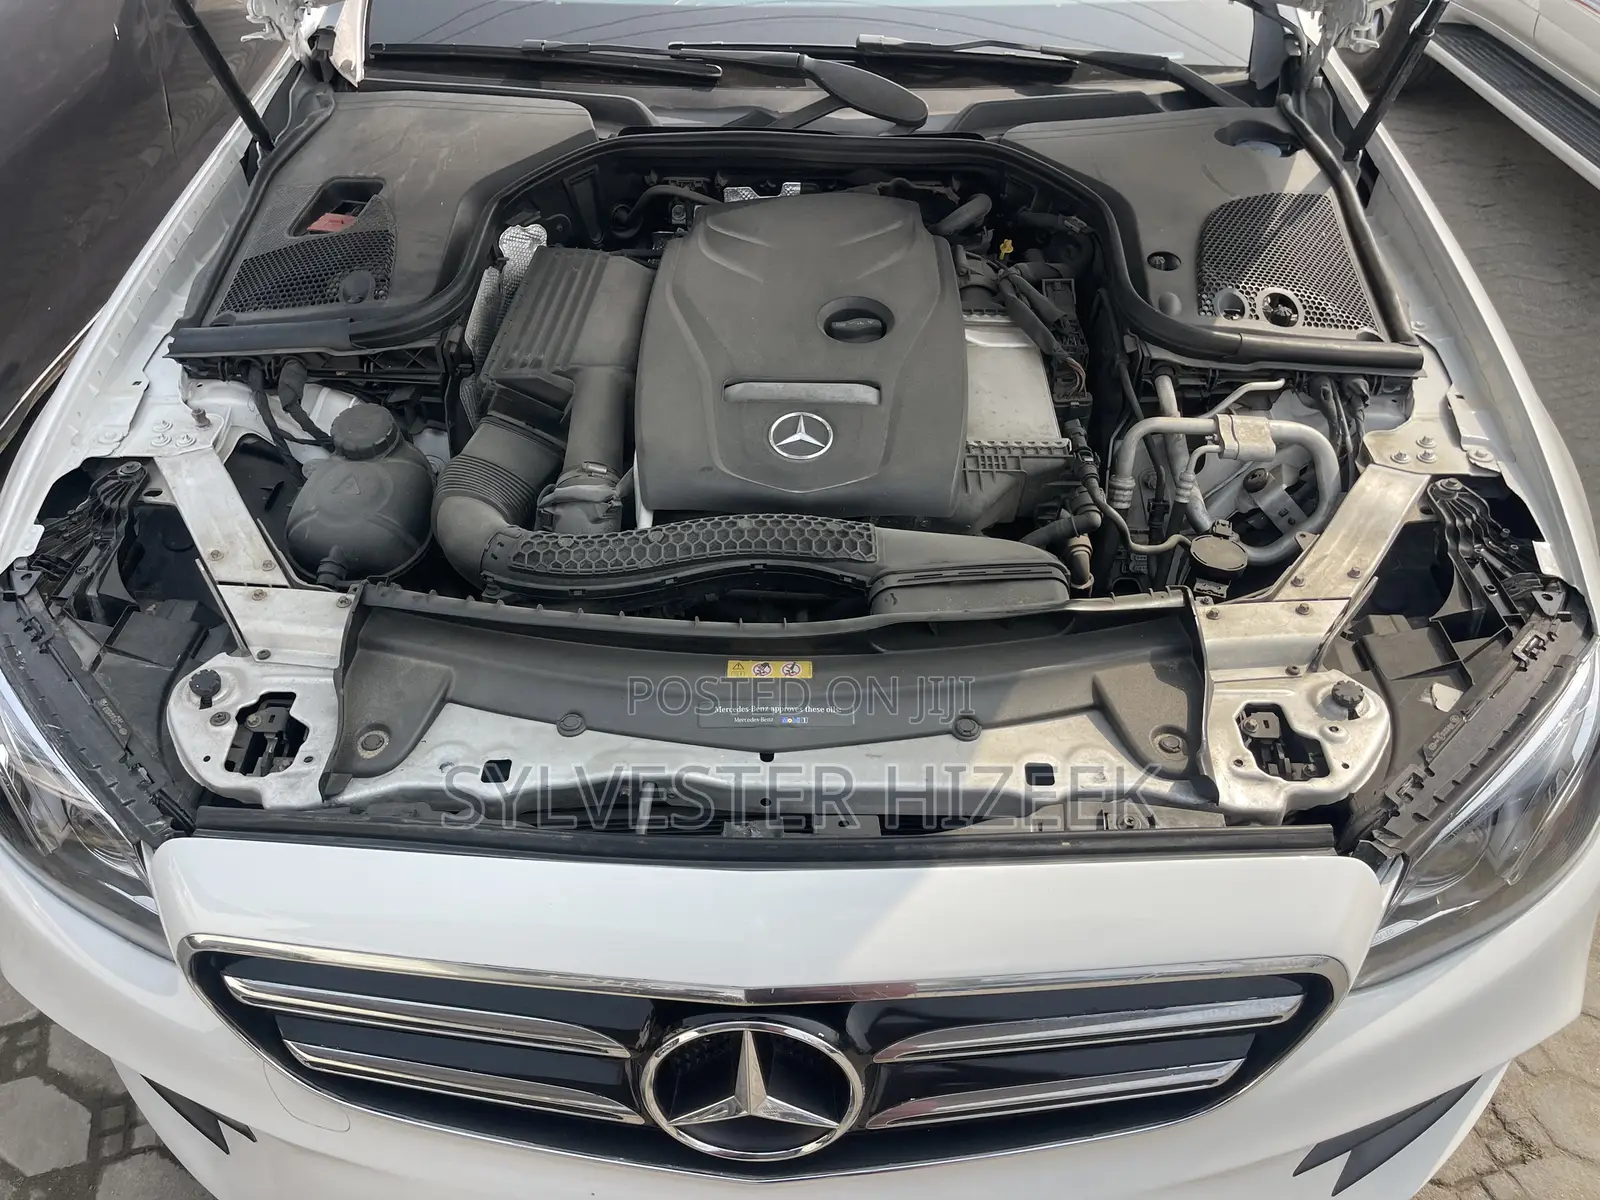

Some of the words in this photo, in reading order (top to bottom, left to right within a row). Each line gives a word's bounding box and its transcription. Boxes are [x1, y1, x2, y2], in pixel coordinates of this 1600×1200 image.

[714, 705, 769, 714] Mercedes-Benz
[770, 705, 803, 716] approves
[804, 704, 825, 714] these
